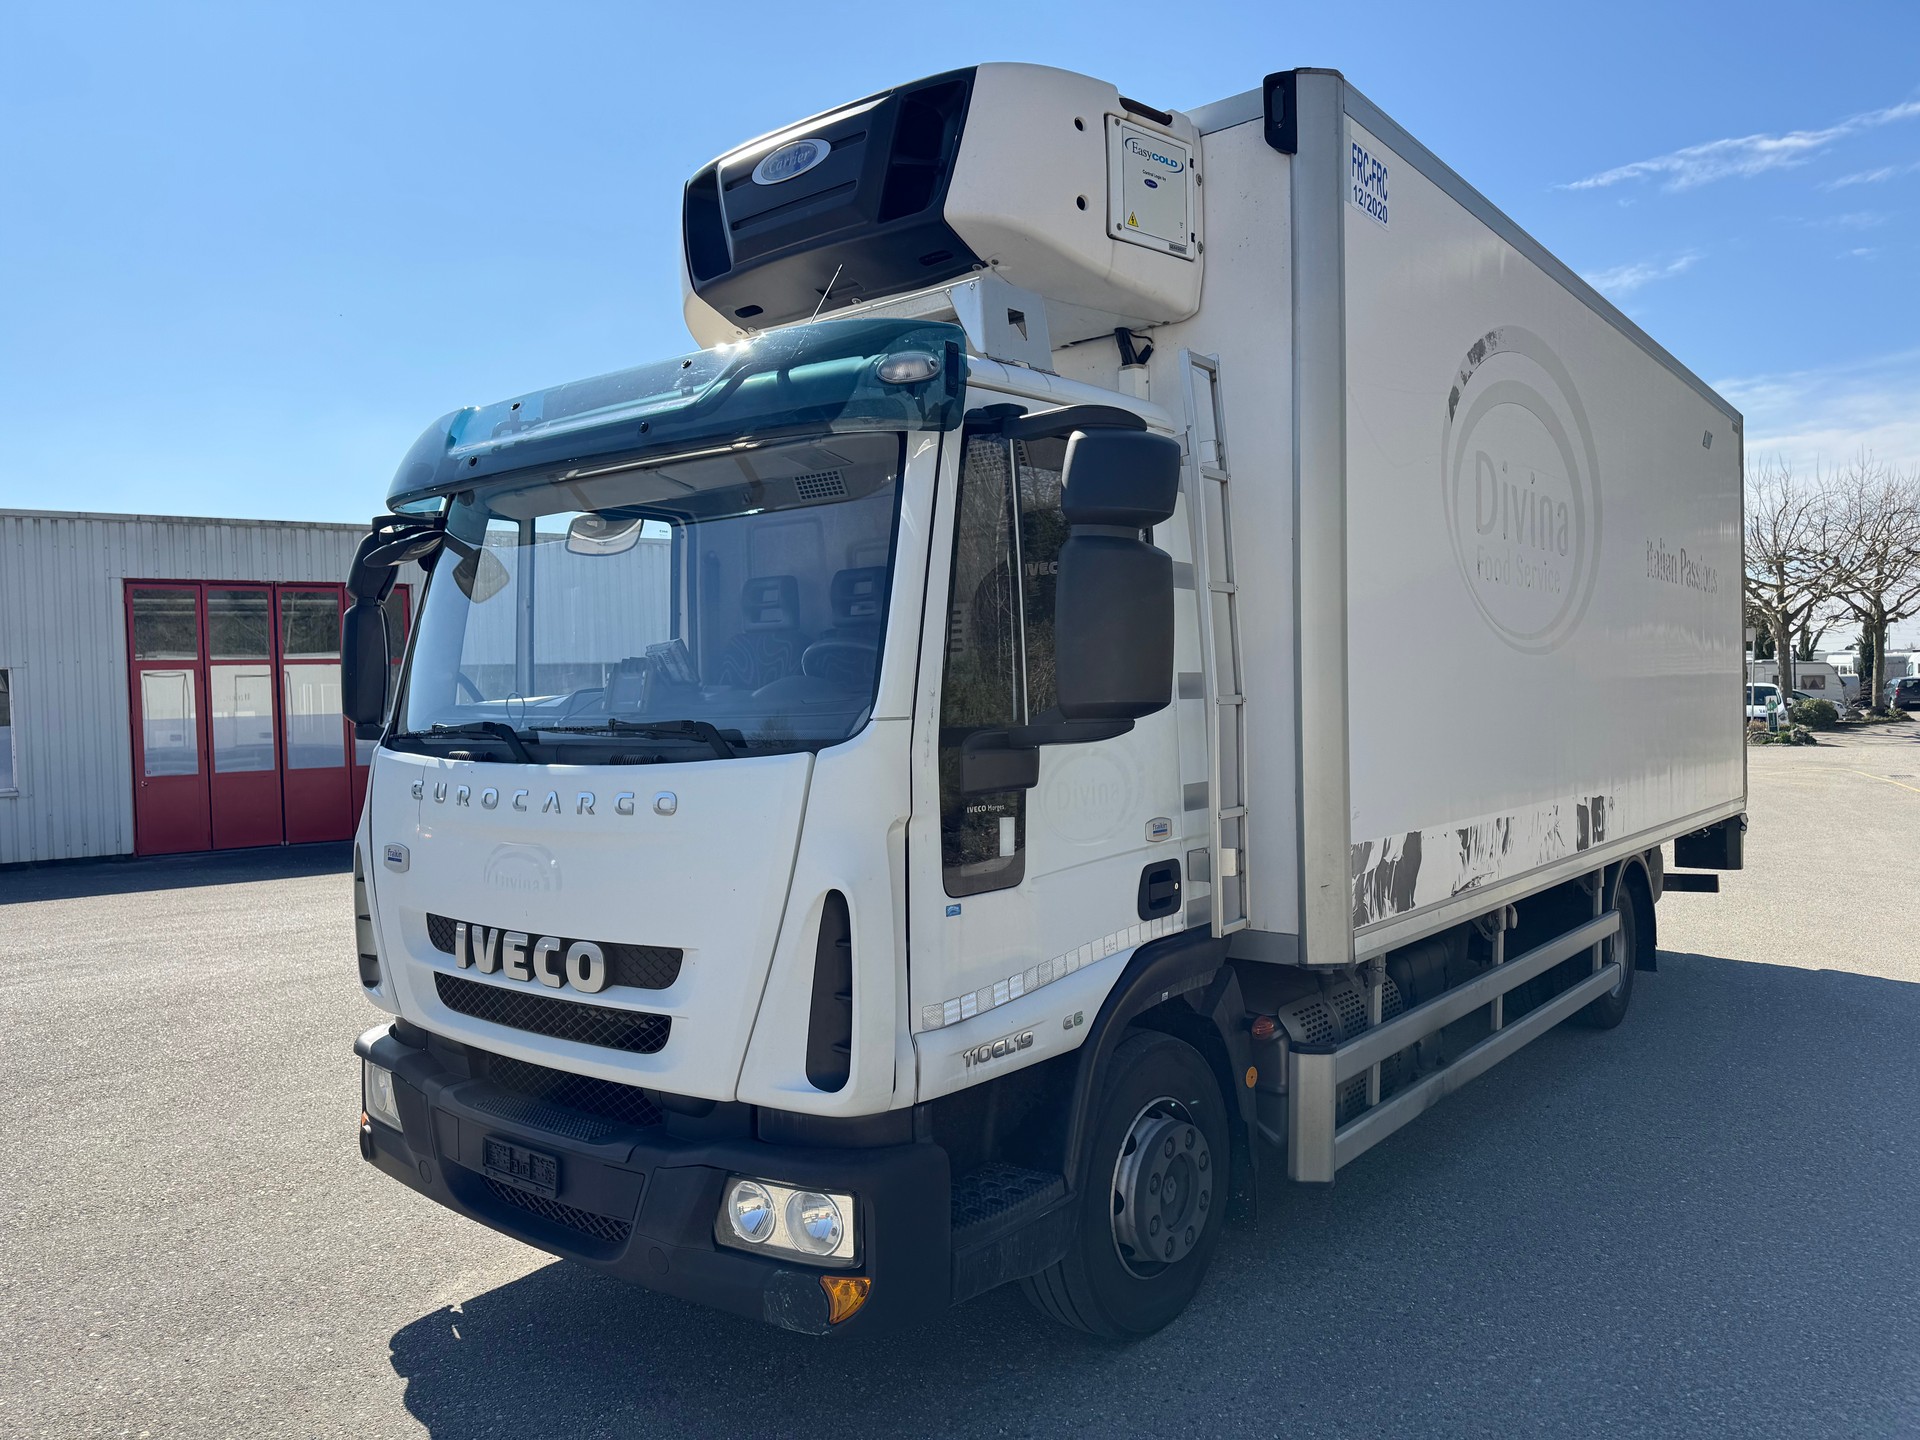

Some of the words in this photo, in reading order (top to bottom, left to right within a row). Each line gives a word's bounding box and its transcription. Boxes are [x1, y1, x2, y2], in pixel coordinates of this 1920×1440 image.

[768, 150, 810, 173] Carrier
[1352, 142, 1388, 201] FRC-FRC
[1353, 184, 1388, 224] 12/2020
[1475, 450, 1569, 557] Divina
[1024, 561, 1058, 577] IVEC
[1476, 545, 1511, 585] Food
[1516, 554, 1561, 594] Service
[1646, 536, 1678, 584] Italian
[1680, 547, 1718, 594] Passions
[411, 779, 678, 816] EUROCARGO
[966, 804, 987, 814] IVECO
[987, 803, 1005, 812] Morges
[455, 922, 607, 993] IVECO
[963, 1031, 1034, 1067] 110EL19
